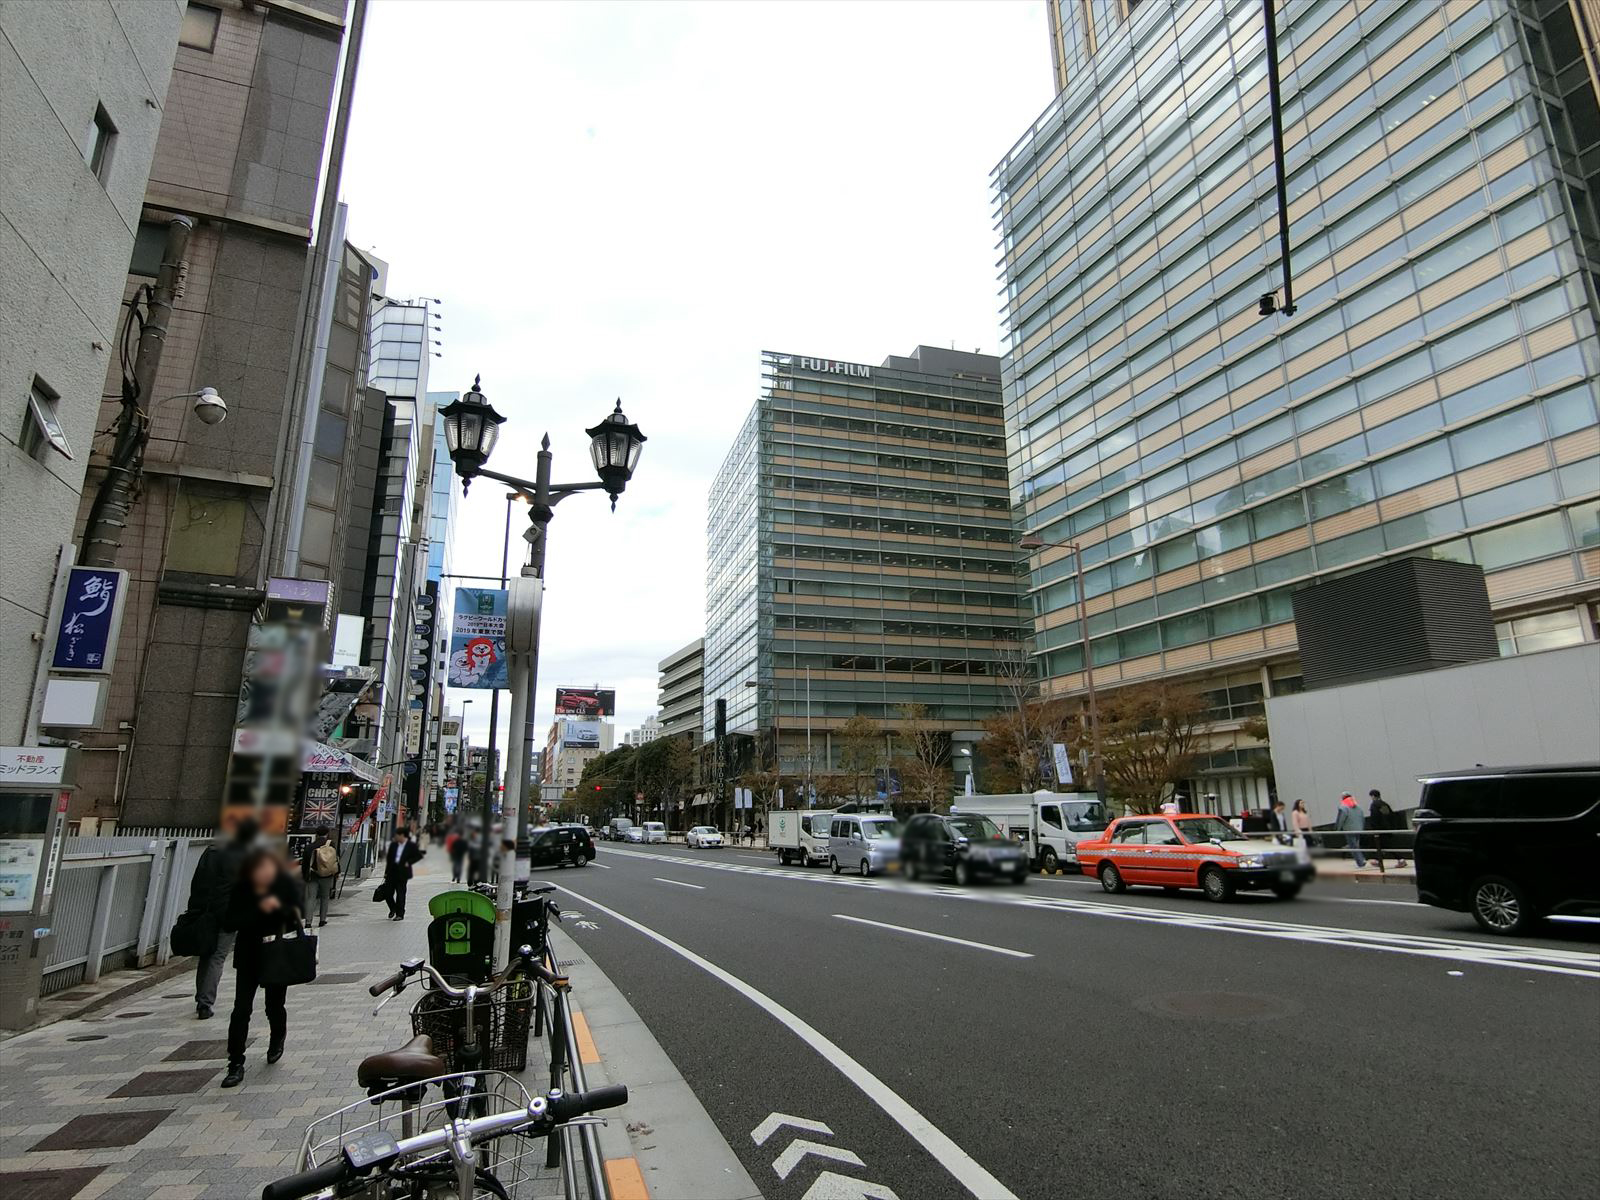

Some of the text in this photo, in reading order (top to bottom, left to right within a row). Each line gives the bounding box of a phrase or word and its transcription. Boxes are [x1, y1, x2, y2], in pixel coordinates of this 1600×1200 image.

[800, 357, 870, 378] FUJIFILM
[79, 575, 114, 617] 鮨
[16, 754, 46, 764] 不動産
[0, 764, 62, 775] ミッドランズ
[311, 773, 340, 781] FISH
[320, 781, 329, 789] &
[307, 788, 339, 798] CHIPS
